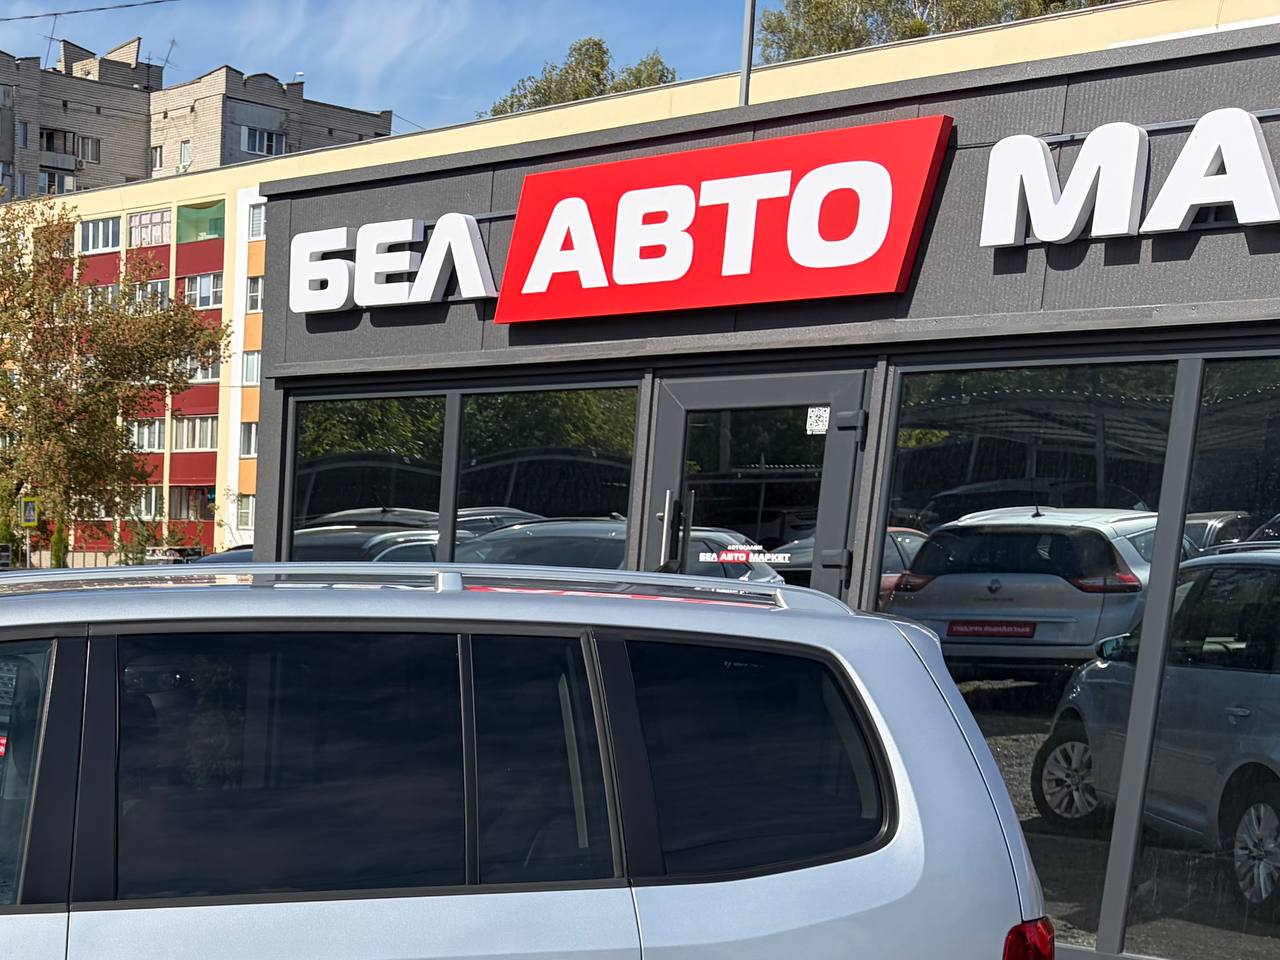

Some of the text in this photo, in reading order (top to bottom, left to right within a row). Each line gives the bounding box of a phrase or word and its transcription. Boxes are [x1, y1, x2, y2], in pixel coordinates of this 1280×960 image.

[289, 107, 1280, 314] БЕЛ АВТО МА
[719, 553, 747, 562] АВТО
[749, 552, 791, 563] МАРКЕТ
